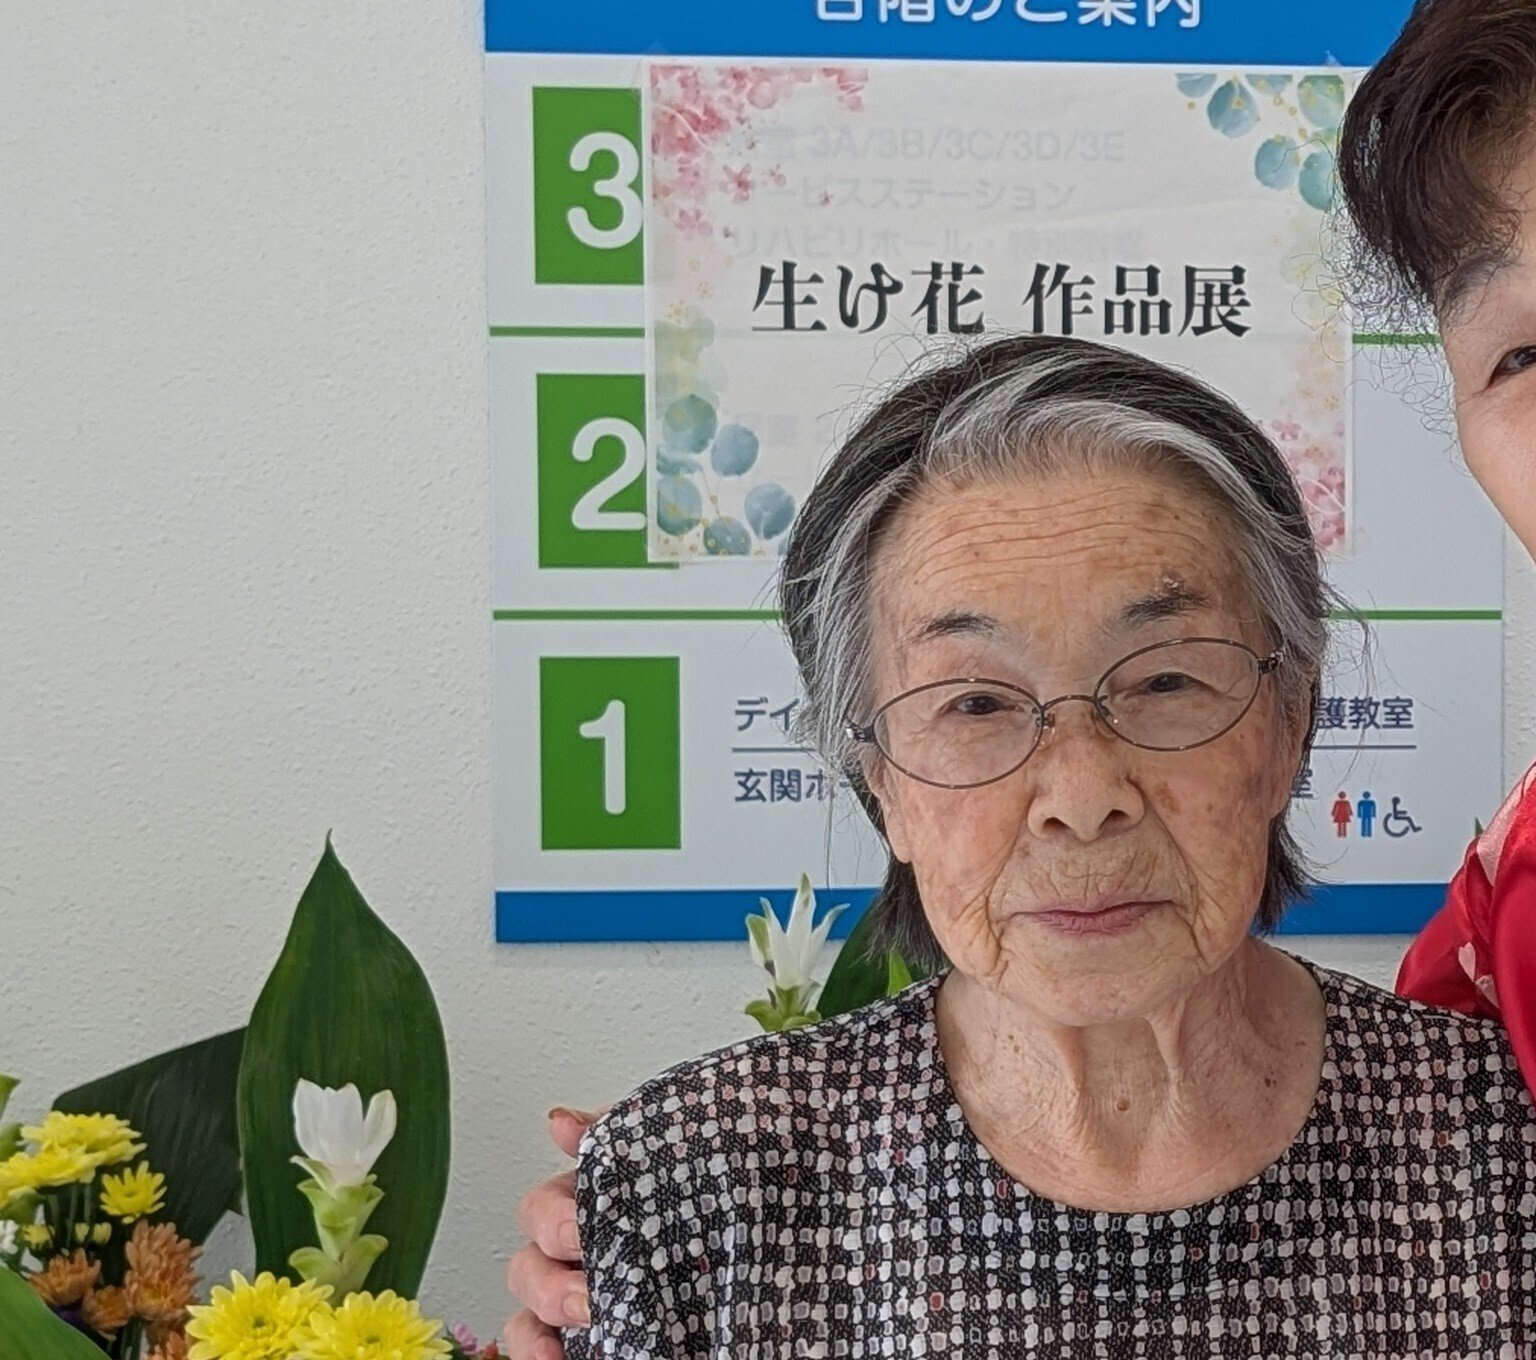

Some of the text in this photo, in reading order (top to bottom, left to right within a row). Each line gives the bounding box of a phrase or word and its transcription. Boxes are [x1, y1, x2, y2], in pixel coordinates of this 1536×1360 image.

[565, 130, 645, 249] 3
[752, 259, 1254, 342] 生け花 作品展
[570, 416, 648, 531] 2
[579, 697, 628, 817] 1
